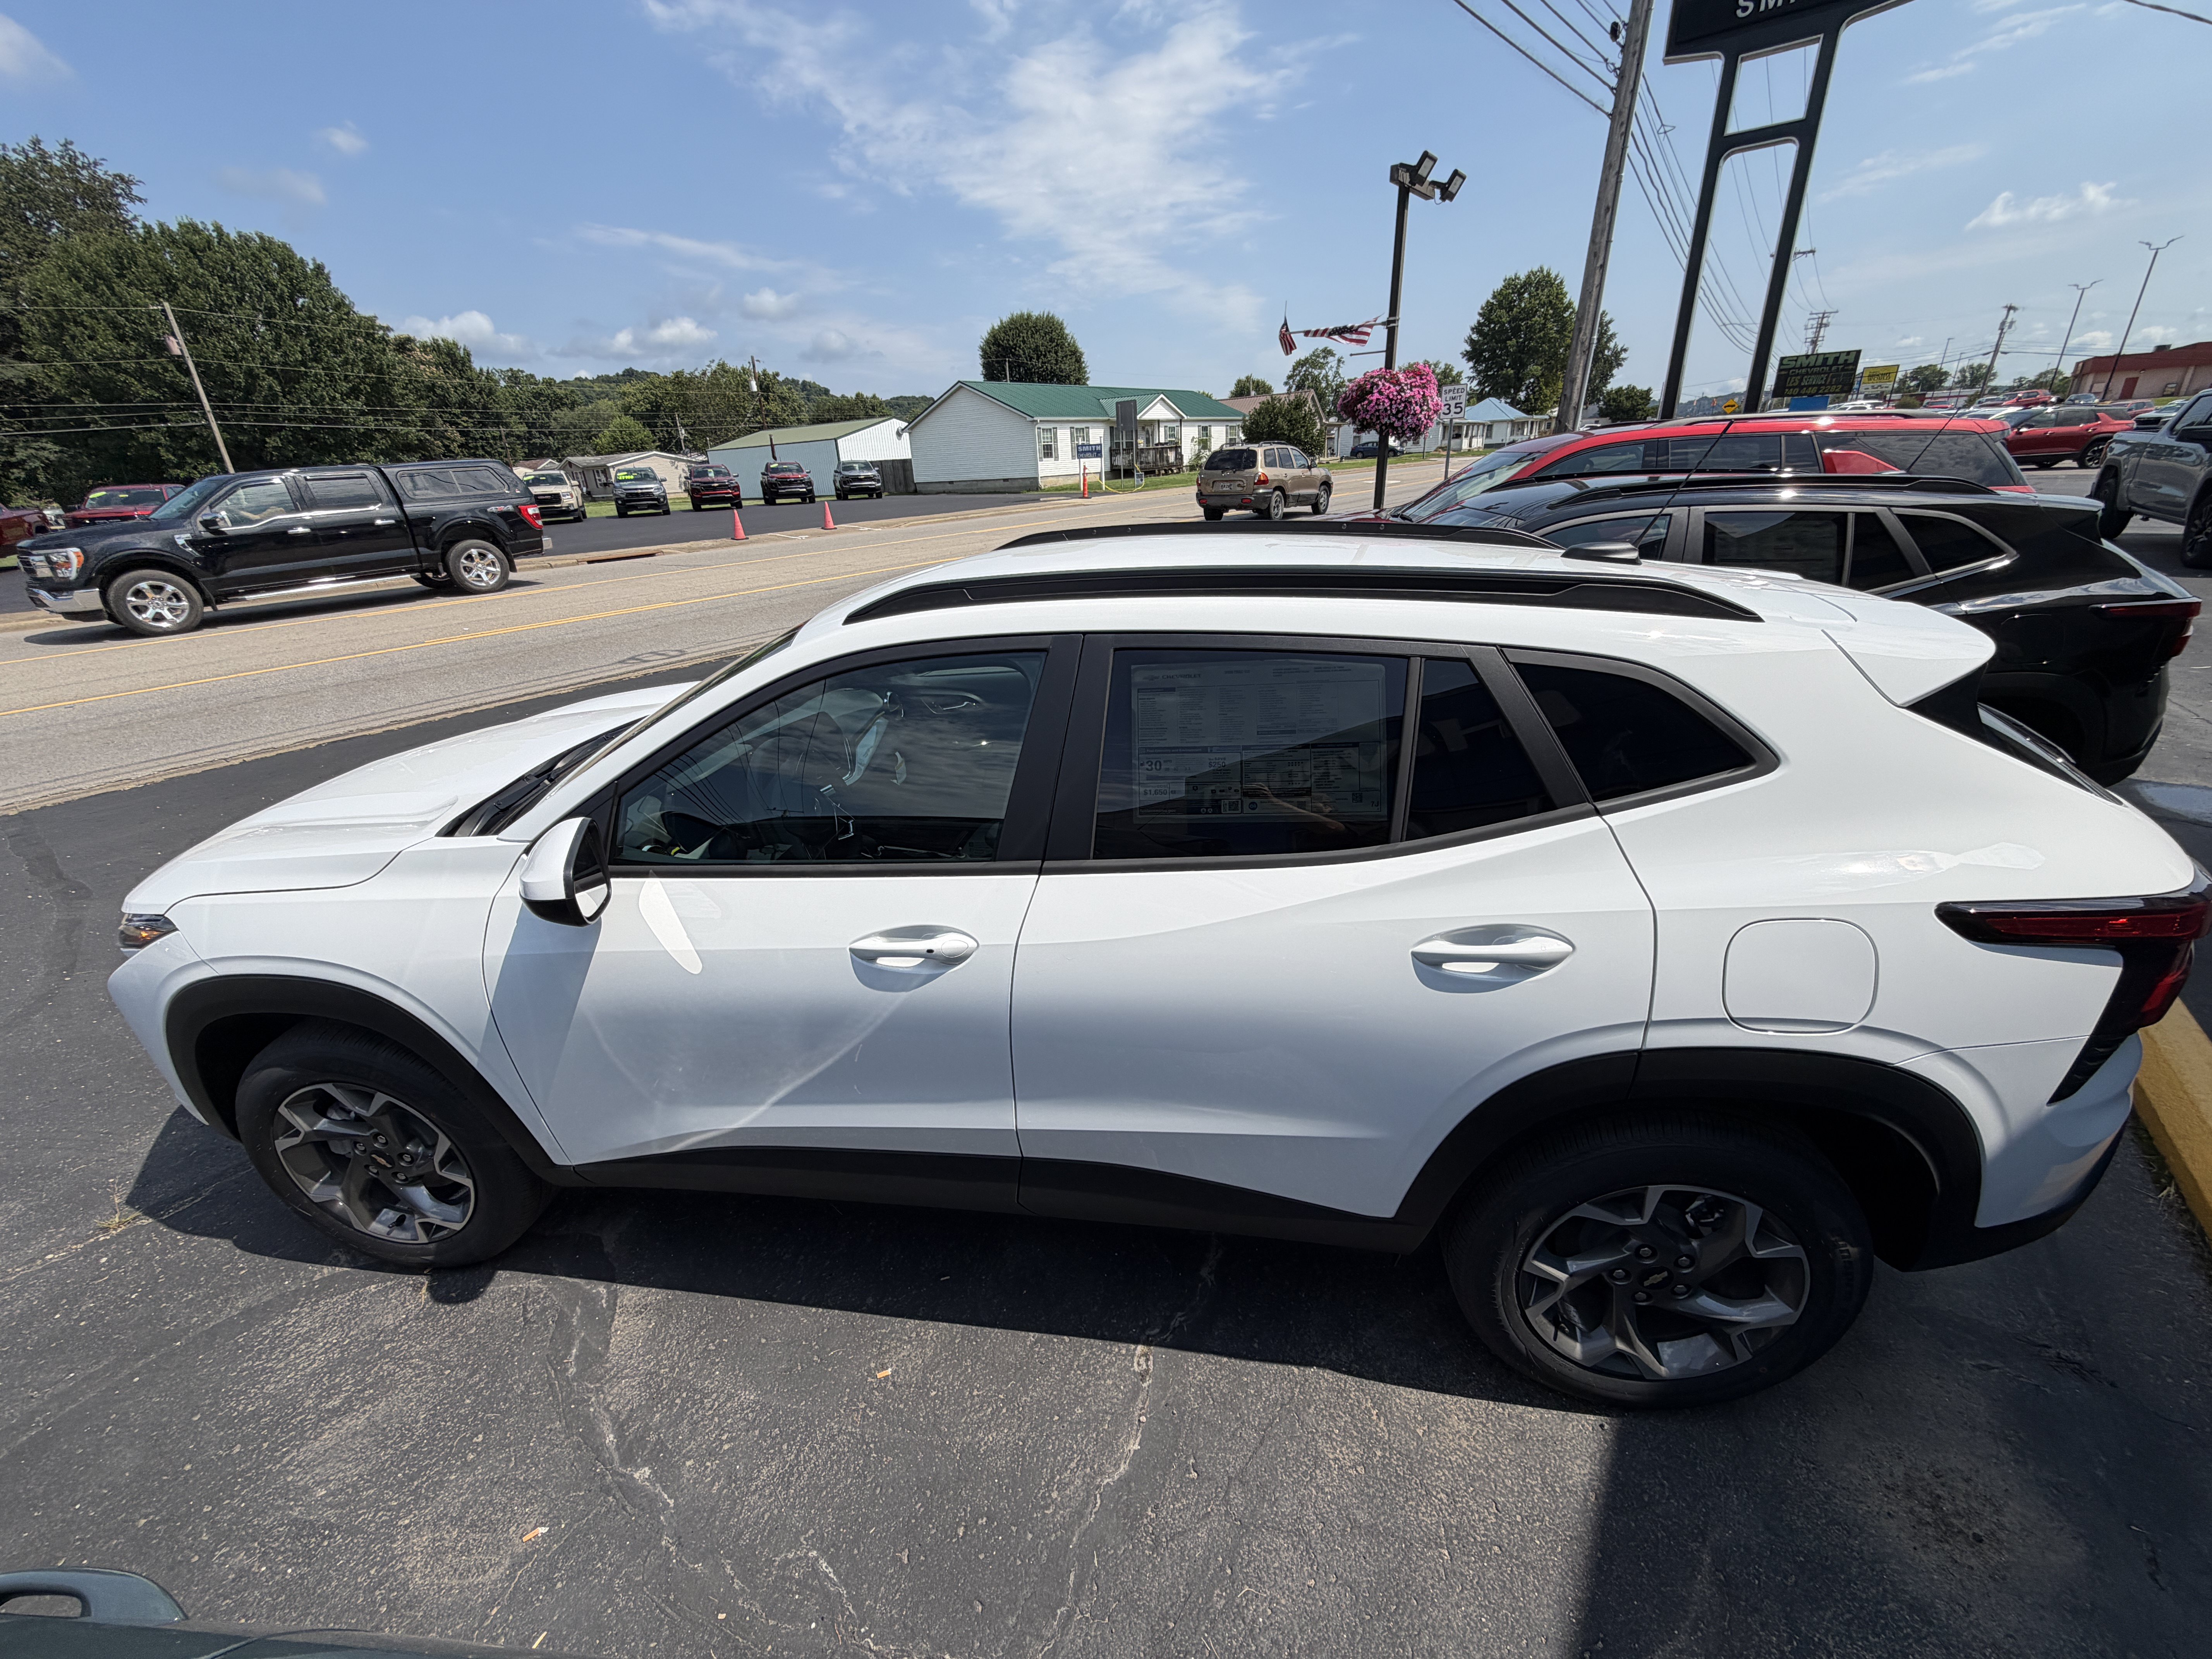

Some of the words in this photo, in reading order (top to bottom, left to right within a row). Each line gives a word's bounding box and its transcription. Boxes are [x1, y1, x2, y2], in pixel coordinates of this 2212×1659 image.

[1780, 351, 1856, 369] SMITH
[1789, 366, 1844, 375] CHEVROLET
[1818, 385, 1842, 393] 2282
[1442, 402, 1463, 415] 35
[1146, 760, 1162, 771] 30
